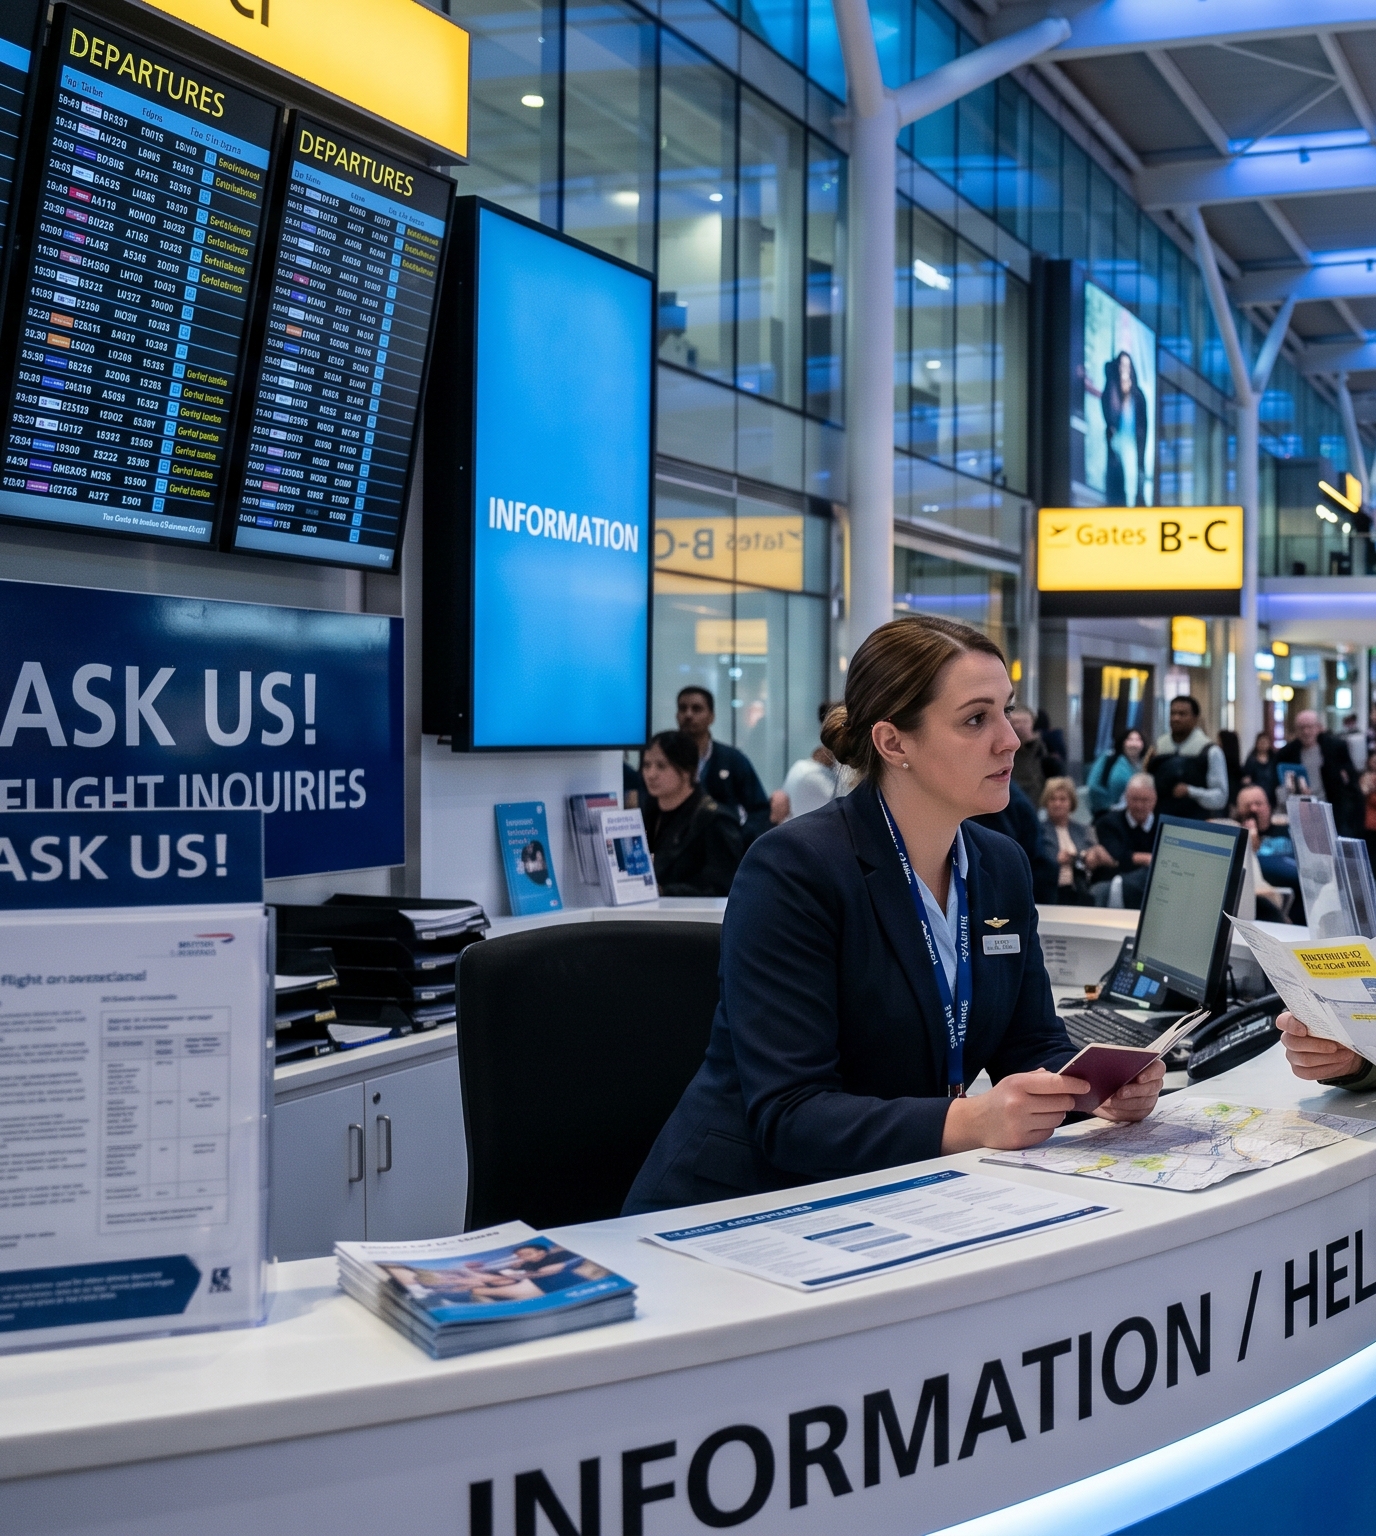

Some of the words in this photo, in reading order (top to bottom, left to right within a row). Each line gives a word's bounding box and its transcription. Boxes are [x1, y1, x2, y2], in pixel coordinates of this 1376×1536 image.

[69, 27, 226, 118] DEPARTURES
[299, 129, 415, 197] DEPARTURES
[488, 496, 639, 553] INFORMATION
[1076, 523, 1147, 547] Gates
[1160, 519, 1228, 552] B-C
[0, 661, 177, 748] ASK
[204, 669, 317, 747] US!
[179, 768, 367, 814] INQUIRIES
[0, 834, 109, 882] ASK
[130, 833, 228, 879] US!
[469, 1291, 1211, 1536] INFORMATION
[1237, 1269, 1263, 1363] /
